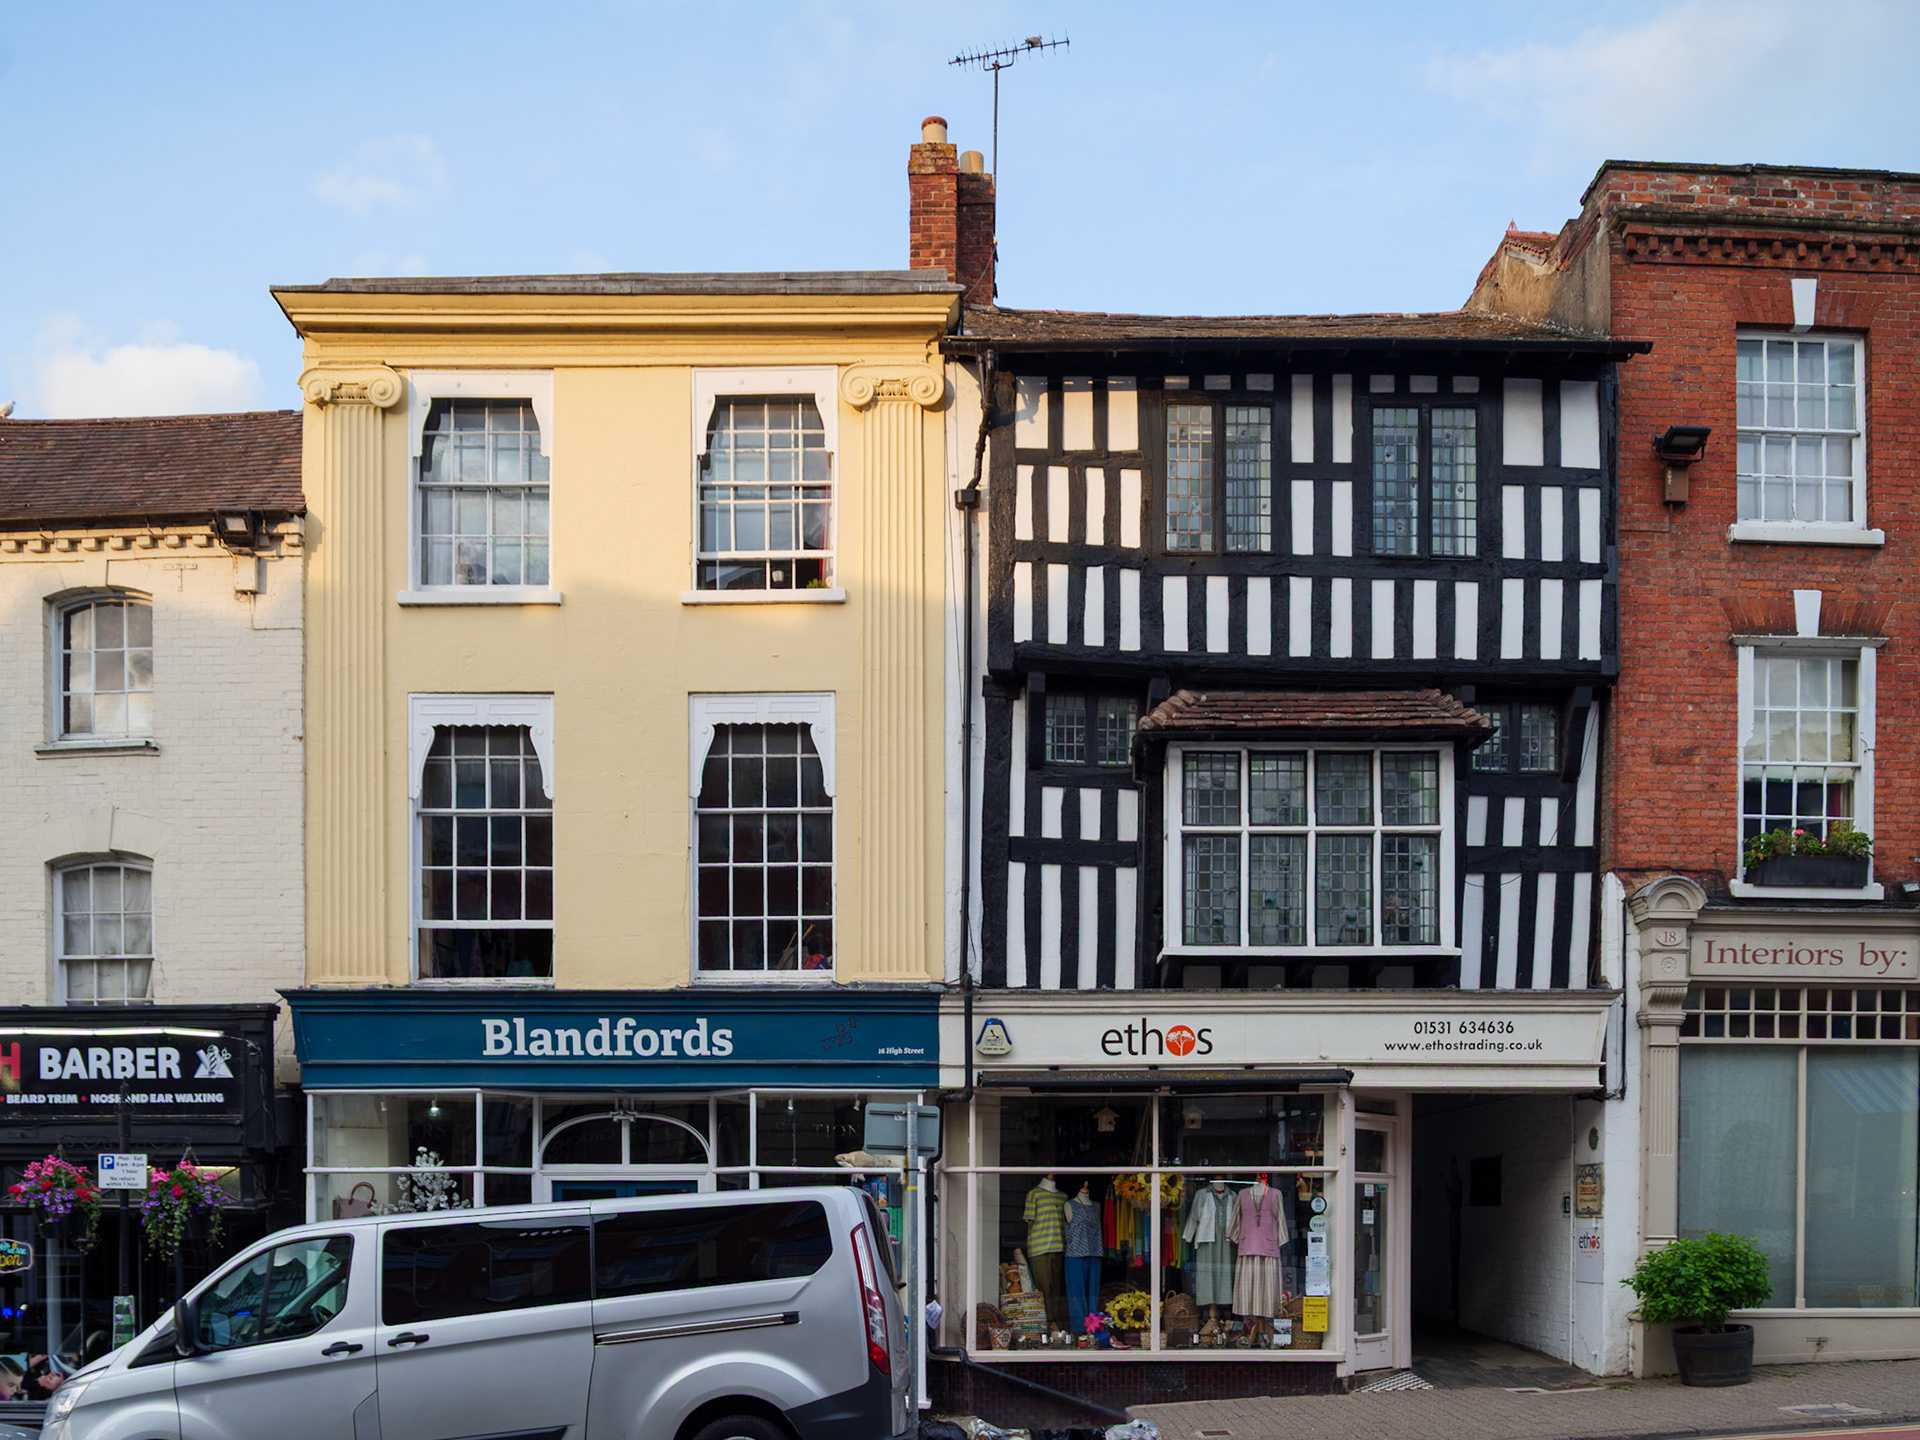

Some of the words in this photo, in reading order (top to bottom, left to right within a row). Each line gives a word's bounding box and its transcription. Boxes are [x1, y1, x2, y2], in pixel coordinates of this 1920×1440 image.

[1662, 931, 1677, 944] 18
[1703, 939, 1844, 967] Interiors
[1858, 941, 1908, 975] by:
[1413, 1021, 1452, 1035] 01531
[1458, 1020, 1515, 1035] 634636
[481, 1017, 734, 1057] Blandfords
[1101, 1017, 1214, 1057] ethos
[886, 1047, 903, 1056] High
[903, 1047, 925, 1055] Street
[1384, 1038, 1544, 1053] www.ethostrading.co.uk
[39, 1047, 182, 1080] BARBER
[6, 1093, 49, 1104] BEARD
[48, 1093, 79, 1104] TRIM
[90, 1093, 122, 1104] NOSE
[149, 1093, 174, 1103] EAR
[174, 1092, 225, 1103] WAXING
[1578, 1230, 1601, 1249] ethos
